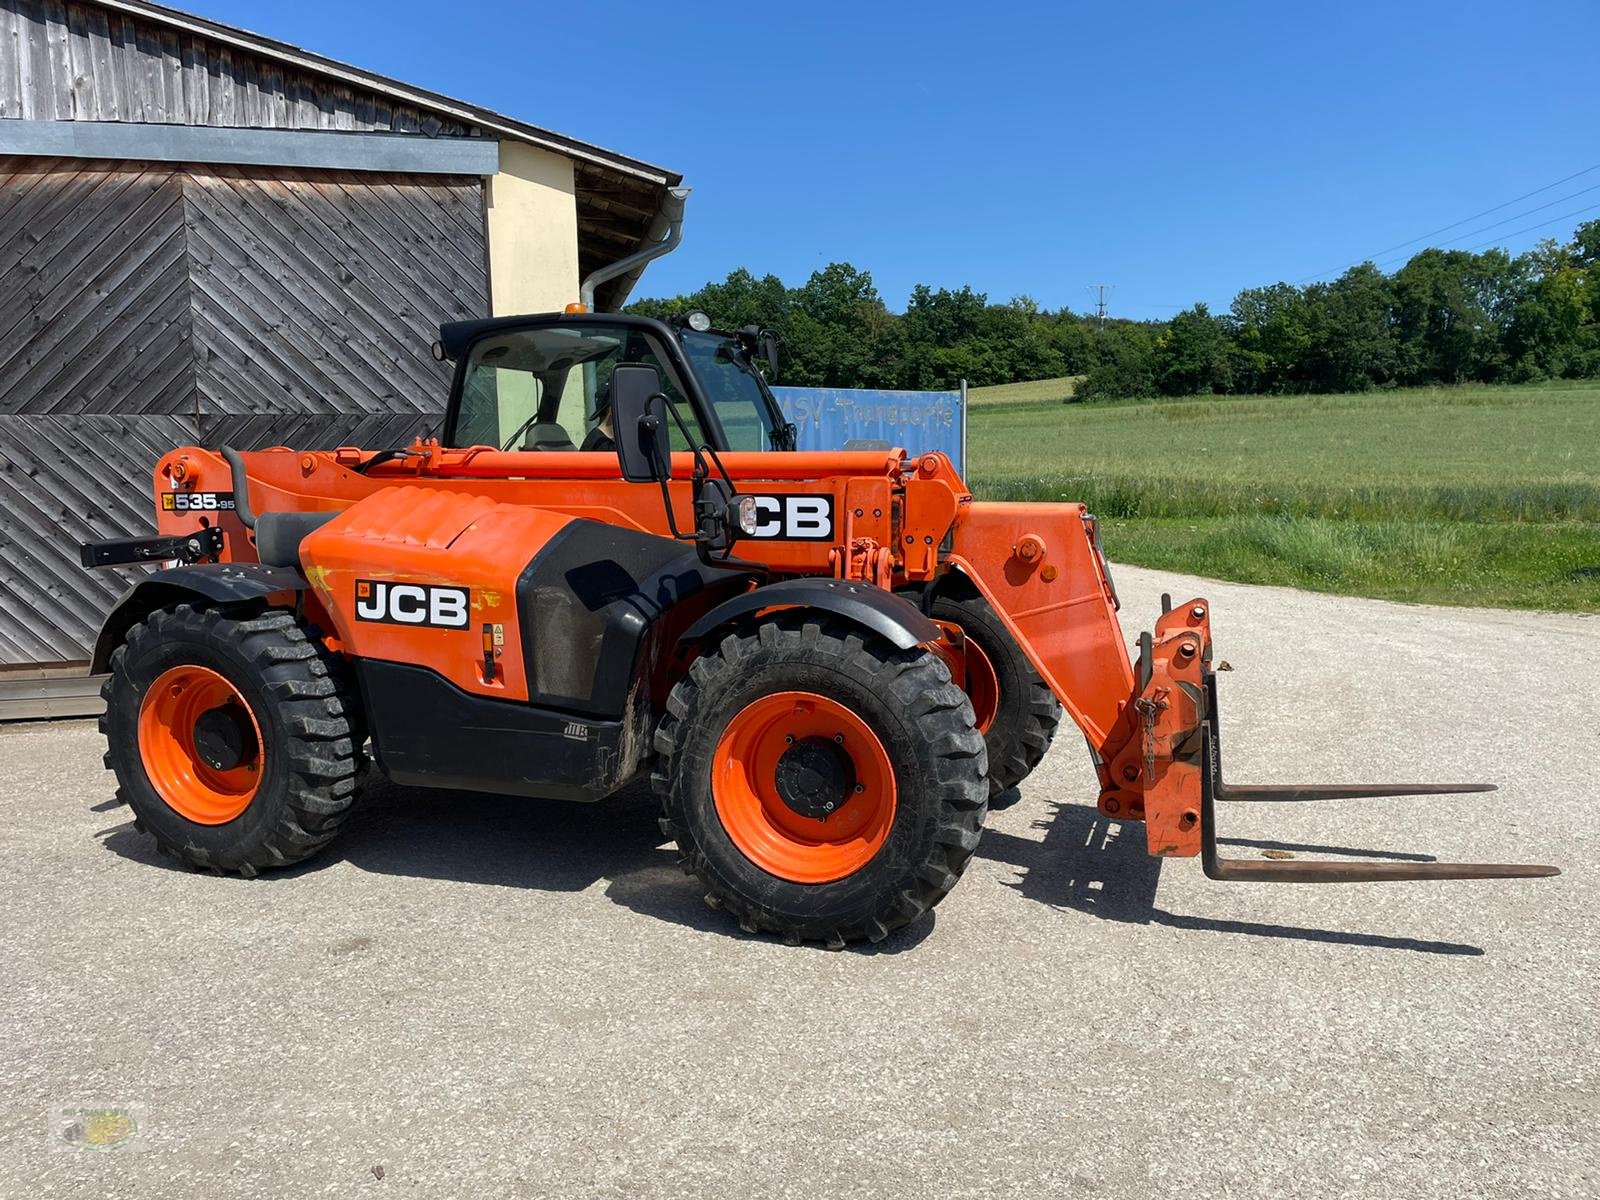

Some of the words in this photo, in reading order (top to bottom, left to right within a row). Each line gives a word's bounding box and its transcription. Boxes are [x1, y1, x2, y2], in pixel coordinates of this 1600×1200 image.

[175, 493, 235, 510] 535-95
[752, 496, 831, 537] CB
[357, 583, 468, 626] JCB
